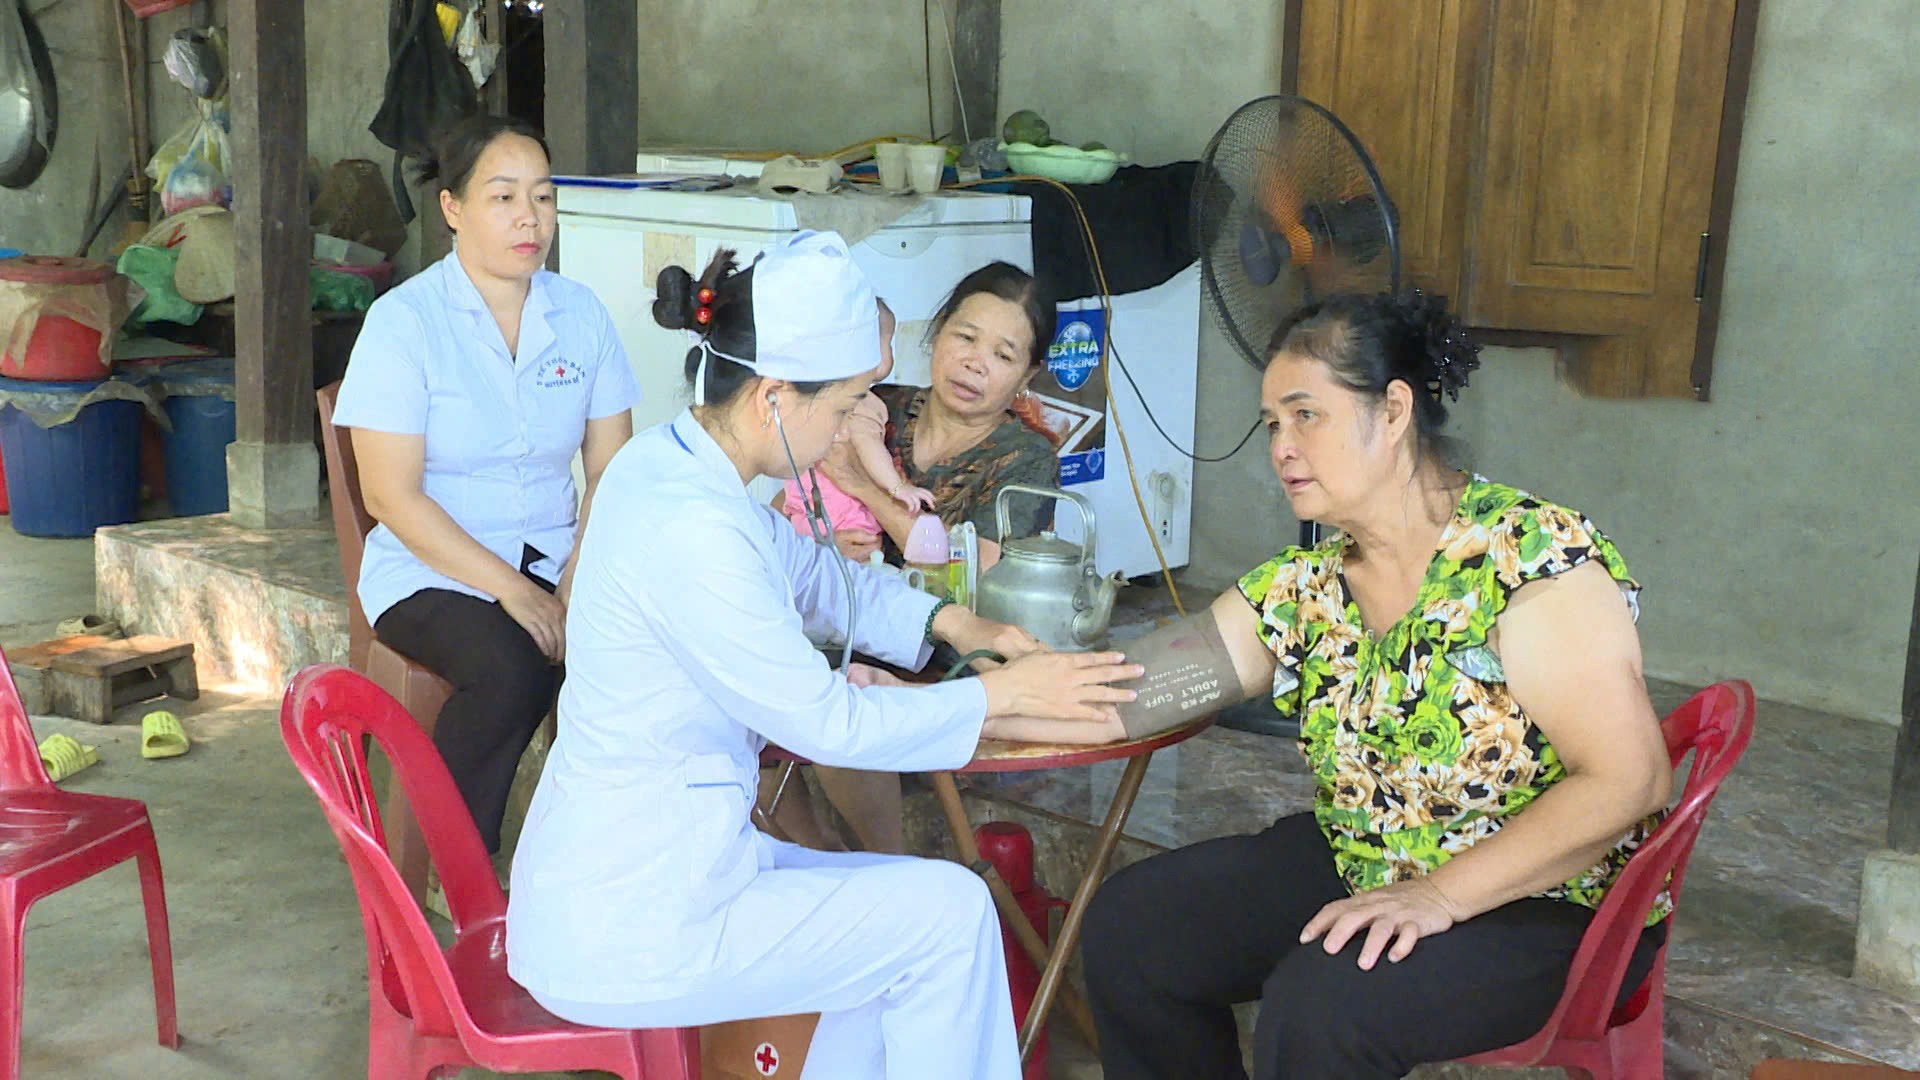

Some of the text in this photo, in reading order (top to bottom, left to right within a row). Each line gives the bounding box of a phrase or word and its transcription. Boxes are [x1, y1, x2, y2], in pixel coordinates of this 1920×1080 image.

[1048, 339, 1099, 359] EXTRA
[1181, 679, 1218, 698] ADULT
[1144, 692, 1174, 710] CUFF
